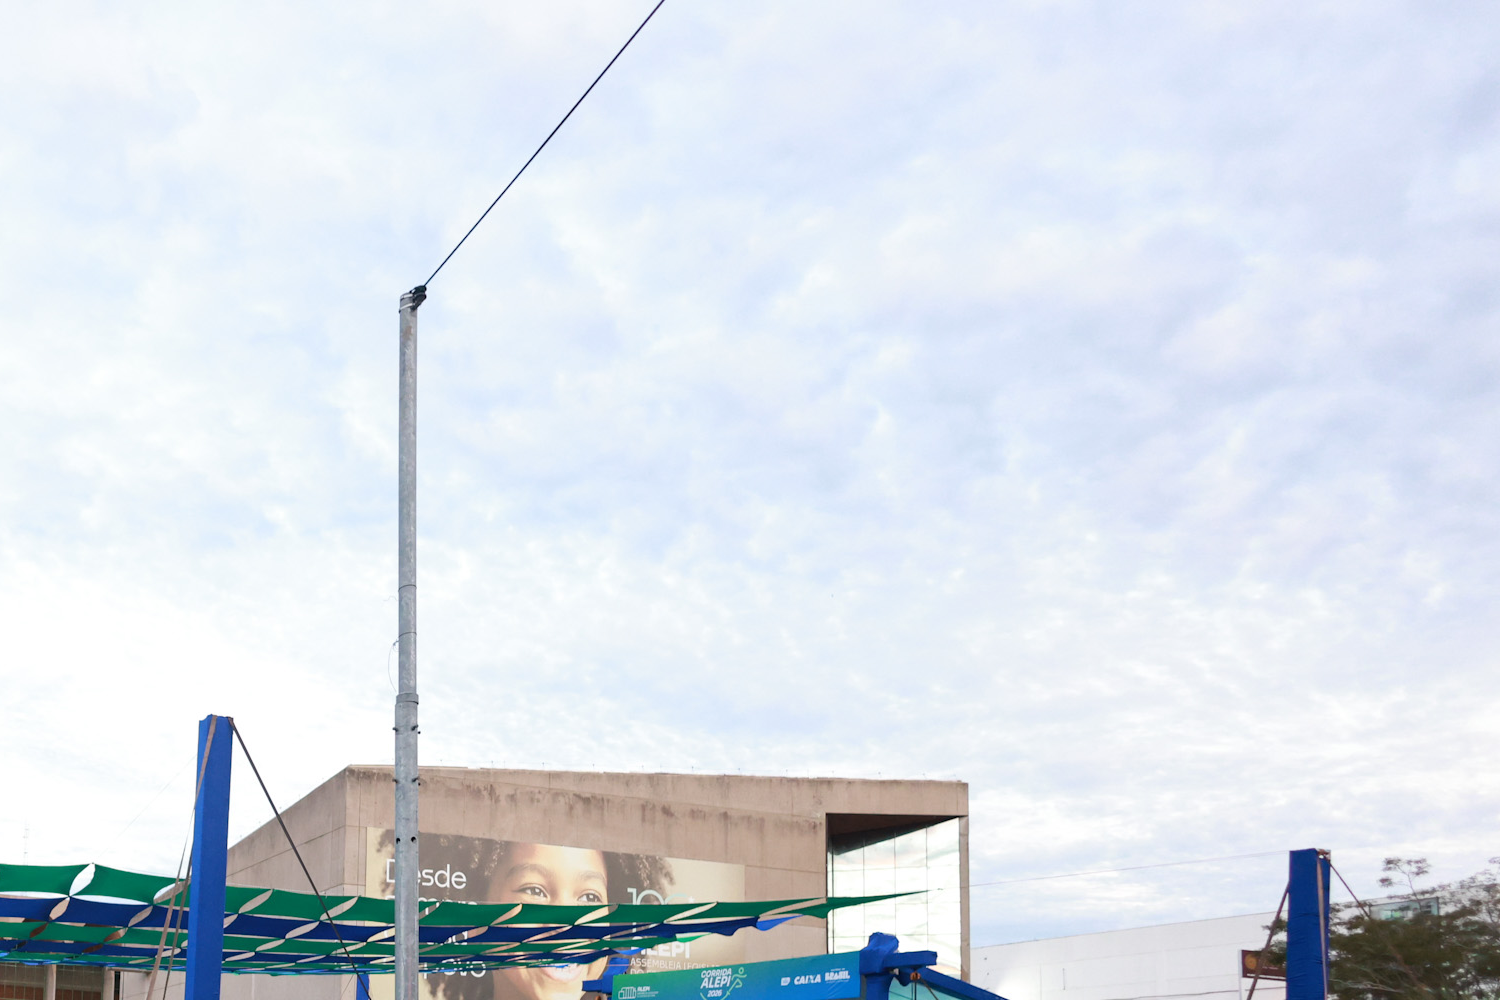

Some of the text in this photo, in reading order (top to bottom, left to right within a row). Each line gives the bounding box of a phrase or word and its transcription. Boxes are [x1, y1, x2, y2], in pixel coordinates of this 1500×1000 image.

[630, 957, 681, 970] ASSEMBLEIA
[701, 968, 732, 979] CORRIDA
[700, 976, 732, 990] ALEPI
[794, 974, 821, 985] CAIXA
[707, 989, 723, 998] 2026
